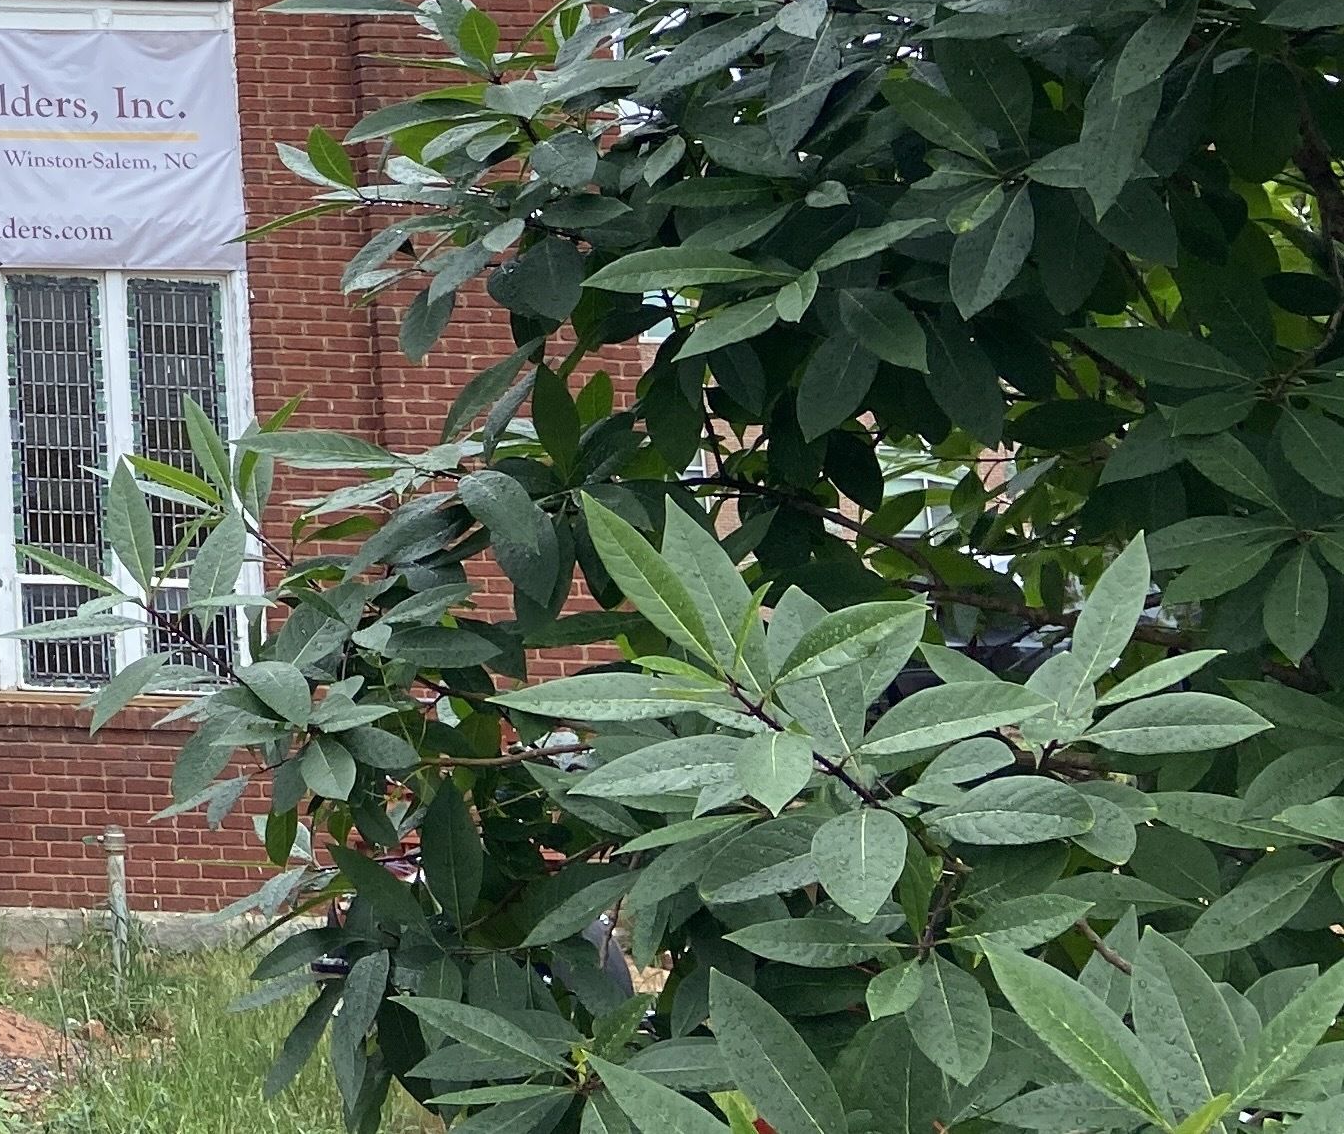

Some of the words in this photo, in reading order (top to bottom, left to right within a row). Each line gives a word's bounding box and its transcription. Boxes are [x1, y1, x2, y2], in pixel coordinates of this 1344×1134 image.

[112, 86, 187, 120] Inc.
[3, 149, 157, 172] Winston-Salem,
[162, 152, 198, 170] NC
